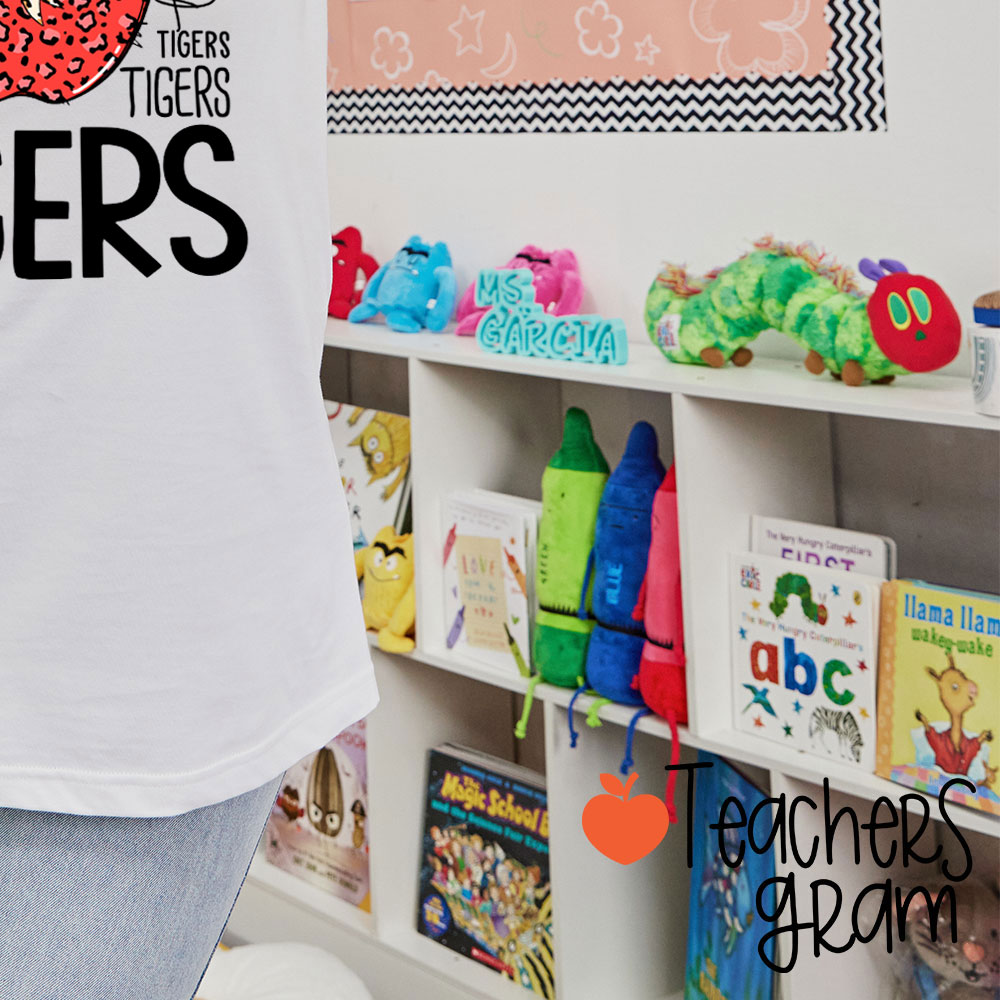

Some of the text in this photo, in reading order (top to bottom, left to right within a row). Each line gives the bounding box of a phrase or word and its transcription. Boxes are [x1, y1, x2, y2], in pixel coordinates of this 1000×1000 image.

[157, 30, 230, 59] TIGERS
[120, 65, 231, 118] TIGERS
[479, 312, 616, 364] GARCIA
[606, 562, 623, 605] BLUE
[904, 593, 1000, 637] llama llam
[750, 637, 856, 706] abc
[440, 772, 487, 811] Magic
[487, 788, 541, 833] School
